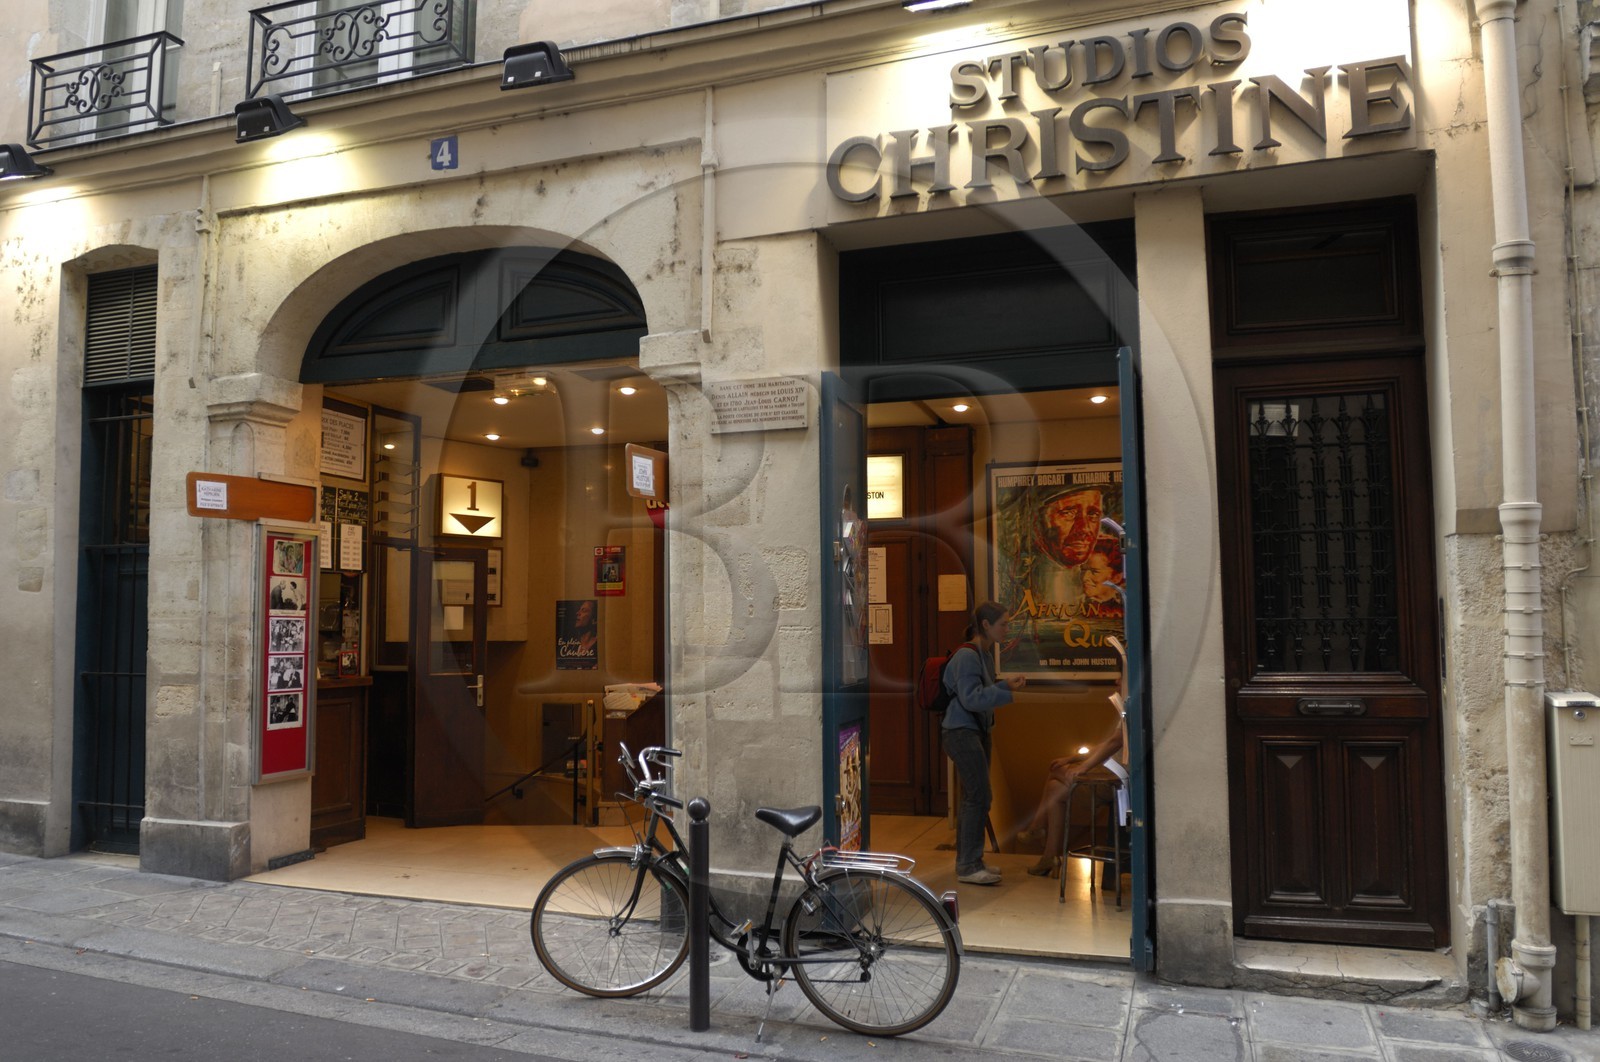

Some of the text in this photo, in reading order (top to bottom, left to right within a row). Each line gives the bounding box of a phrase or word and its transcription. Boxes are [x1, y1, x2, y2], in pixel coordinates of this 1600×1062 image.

[949, 12, 1249, 109] STUDIOS
[826, 55, 1412, 203] CHRISTINE
[436, 141, 451, 166] 4
[727, 391, 748, 399] ALLAIN
[777, 387, 794, 395] LOUIS
[773, 395, 799, 403] CARNOT
[998, 475, 1034, 488] HUMPHREY
[1038, 473, 1065, 486] BOGART
[1072, 471, 1111, 484] KATHARINE
[354, 491, 359, 501] 2
[467, 482, 479, 511] 1
[566, 637, 581, 648] plein
[1049, 658, 1061, 666] film
[1063, 658, 1070, 666] de
[1072, 658, 1090, 666] JOHN
[1091, 657, 1117, 666] HUSTON
